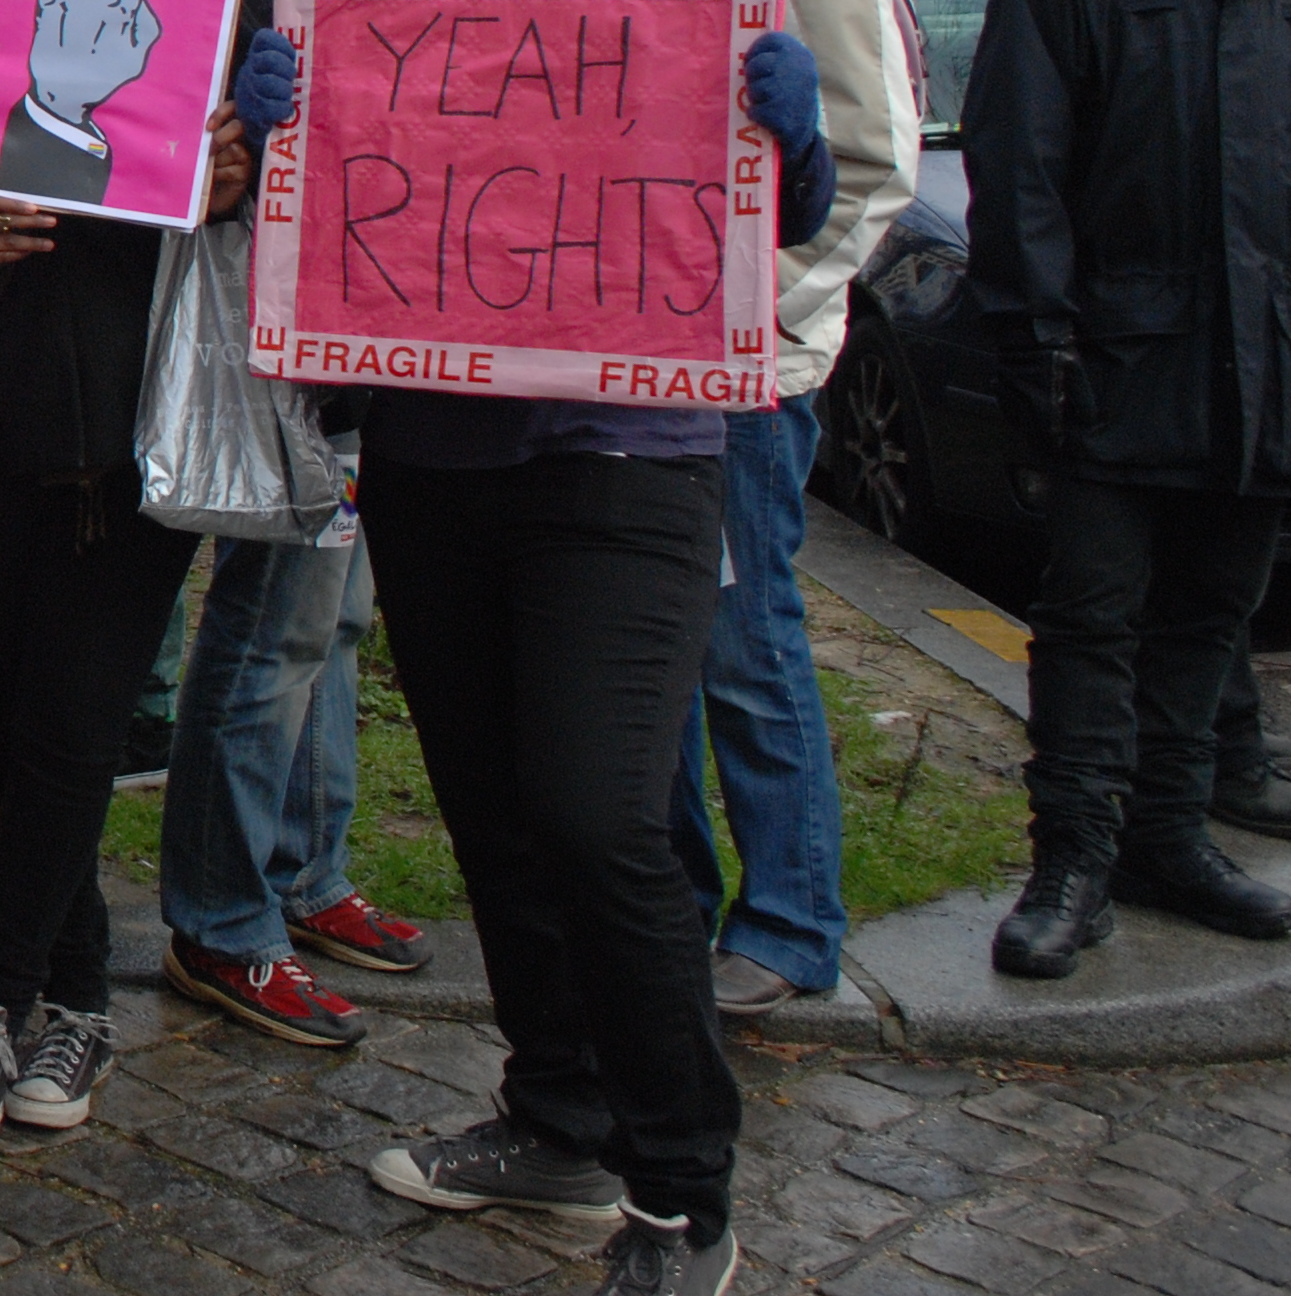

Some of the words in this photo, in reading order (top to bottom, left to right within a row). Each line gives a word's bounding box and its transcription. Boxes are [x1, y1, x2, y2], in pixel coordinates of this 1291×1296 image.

[264, 25, 307, 223] FRAGE
[367, 12, 637, 136] YEAH,
[342, 153, 728, 316] RIGHTS
[294, 339, 495, 384] FRAGILE
